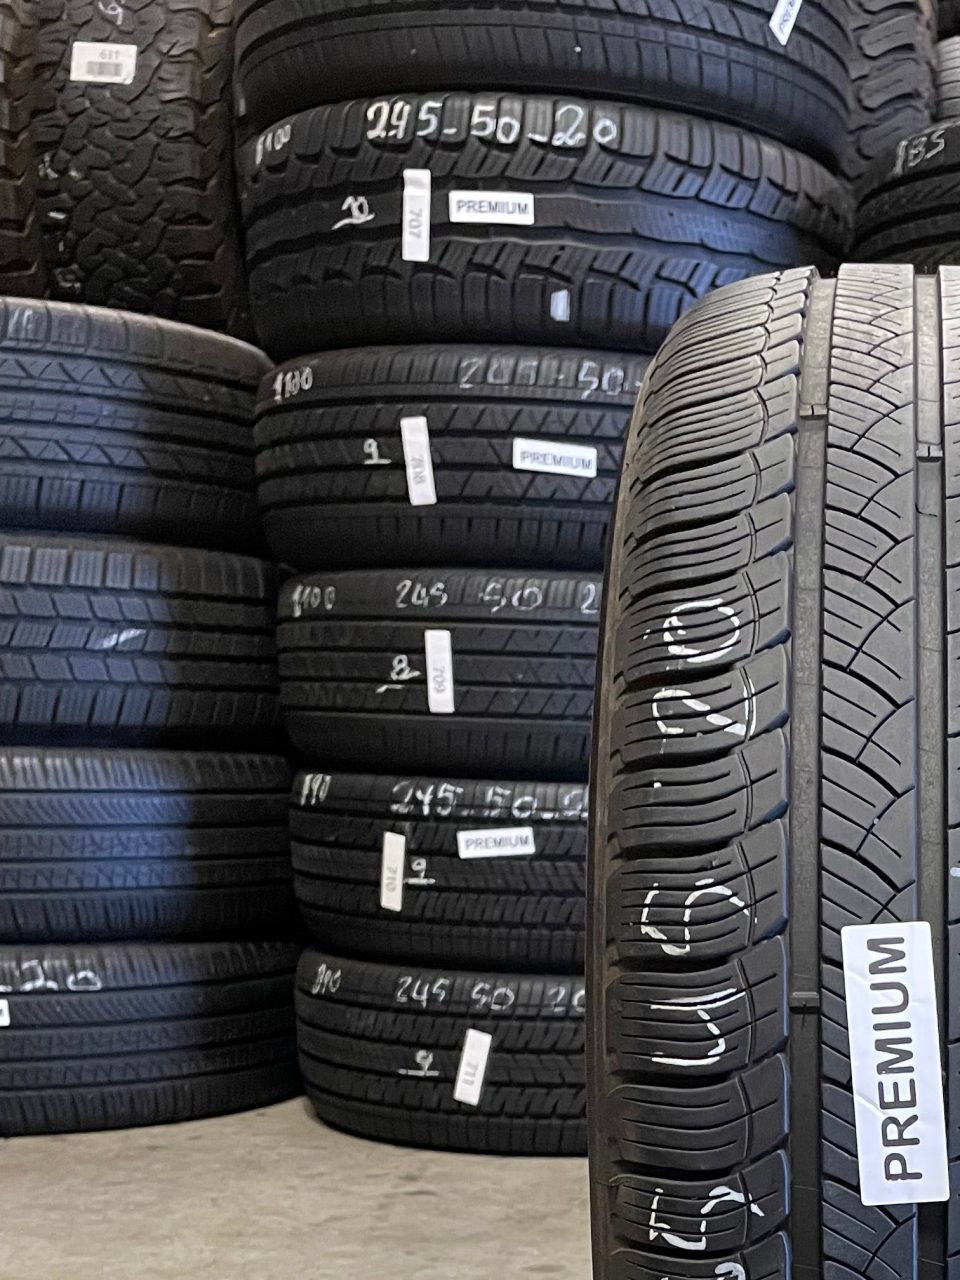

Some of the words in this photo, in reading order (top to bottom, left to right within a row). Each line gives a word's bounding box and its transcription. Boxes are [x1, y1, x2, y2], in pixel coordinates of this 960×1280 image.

[457, 199, 530, 215] PREMIUM
[408, 208, 423, 239] 707
[520, 450, 593, 471] PREMIUM
[396, 579, 448, 608] 245
[652, 598, 757, 738] 20
[465, 835, 530, 851] PREMIUM
[641, 878, 758, 1067] 45
[397, 975, 449, 1008] 245
[471, 982, 514, 1010] 50
[866, 936, 923, 1182] PREMIUM
